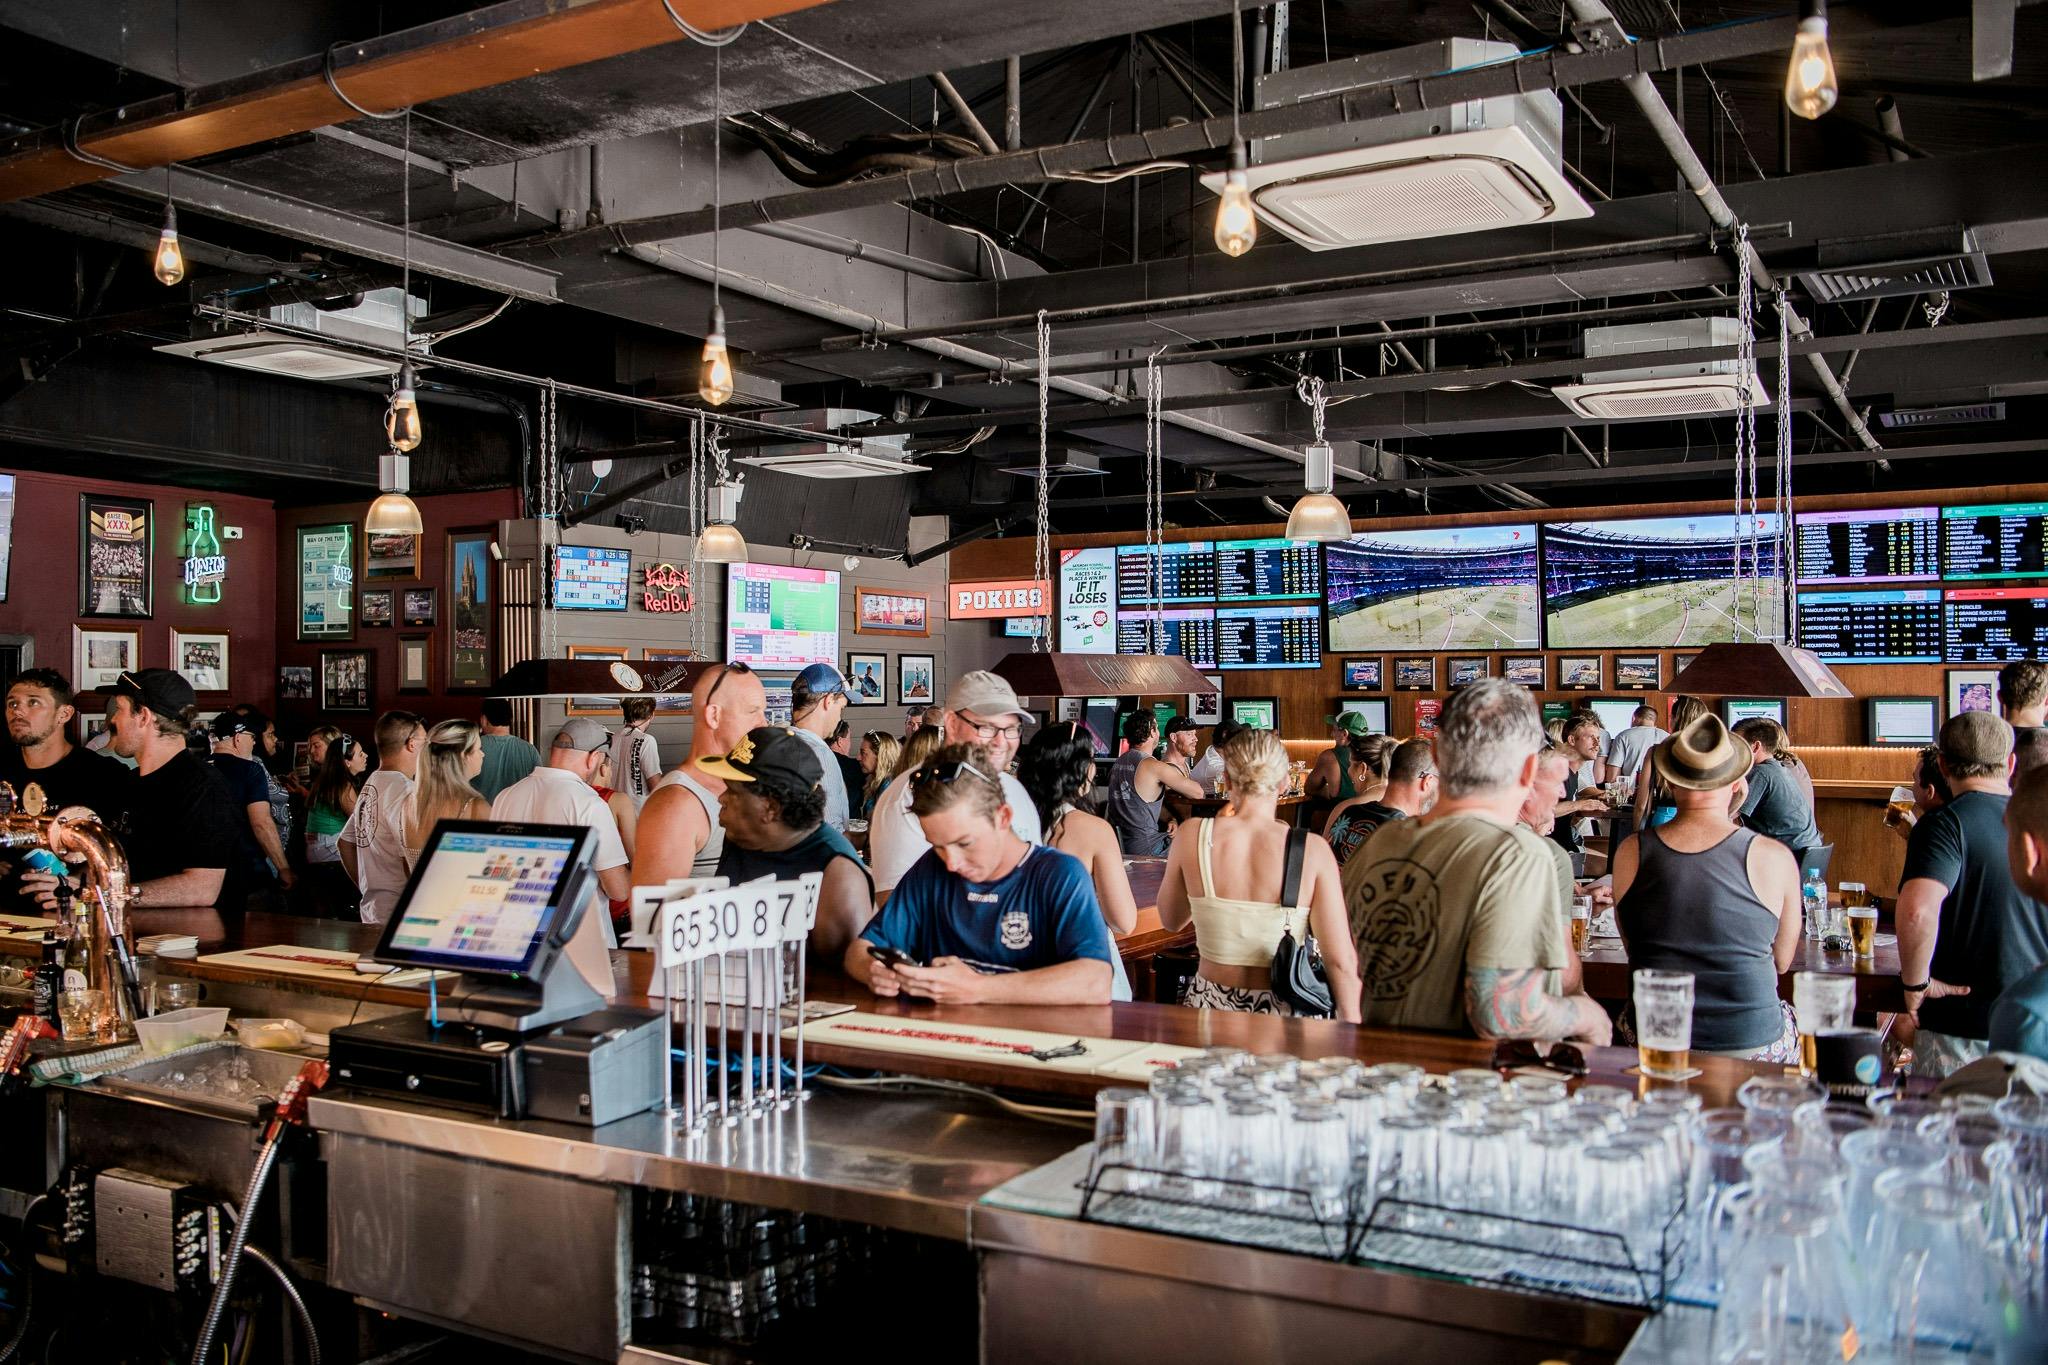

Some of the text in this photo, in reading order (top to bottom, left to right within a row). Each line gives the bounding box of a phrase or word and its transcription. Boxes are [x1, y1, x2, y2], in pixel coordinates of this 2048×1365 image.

[107, 520, 130, 531] XXXX
[1062, 551, 1074, 562] NEW
[1077, 581, 1100, 592] IF IT
[645, 592, 695, 612] Red Bul
[958, 588, 1042, 610] POKIES
[1069, 592, 1107, 604] LOSES
[667, 680, 678, 689] RUM
[777, 893, 794, 927] 7
